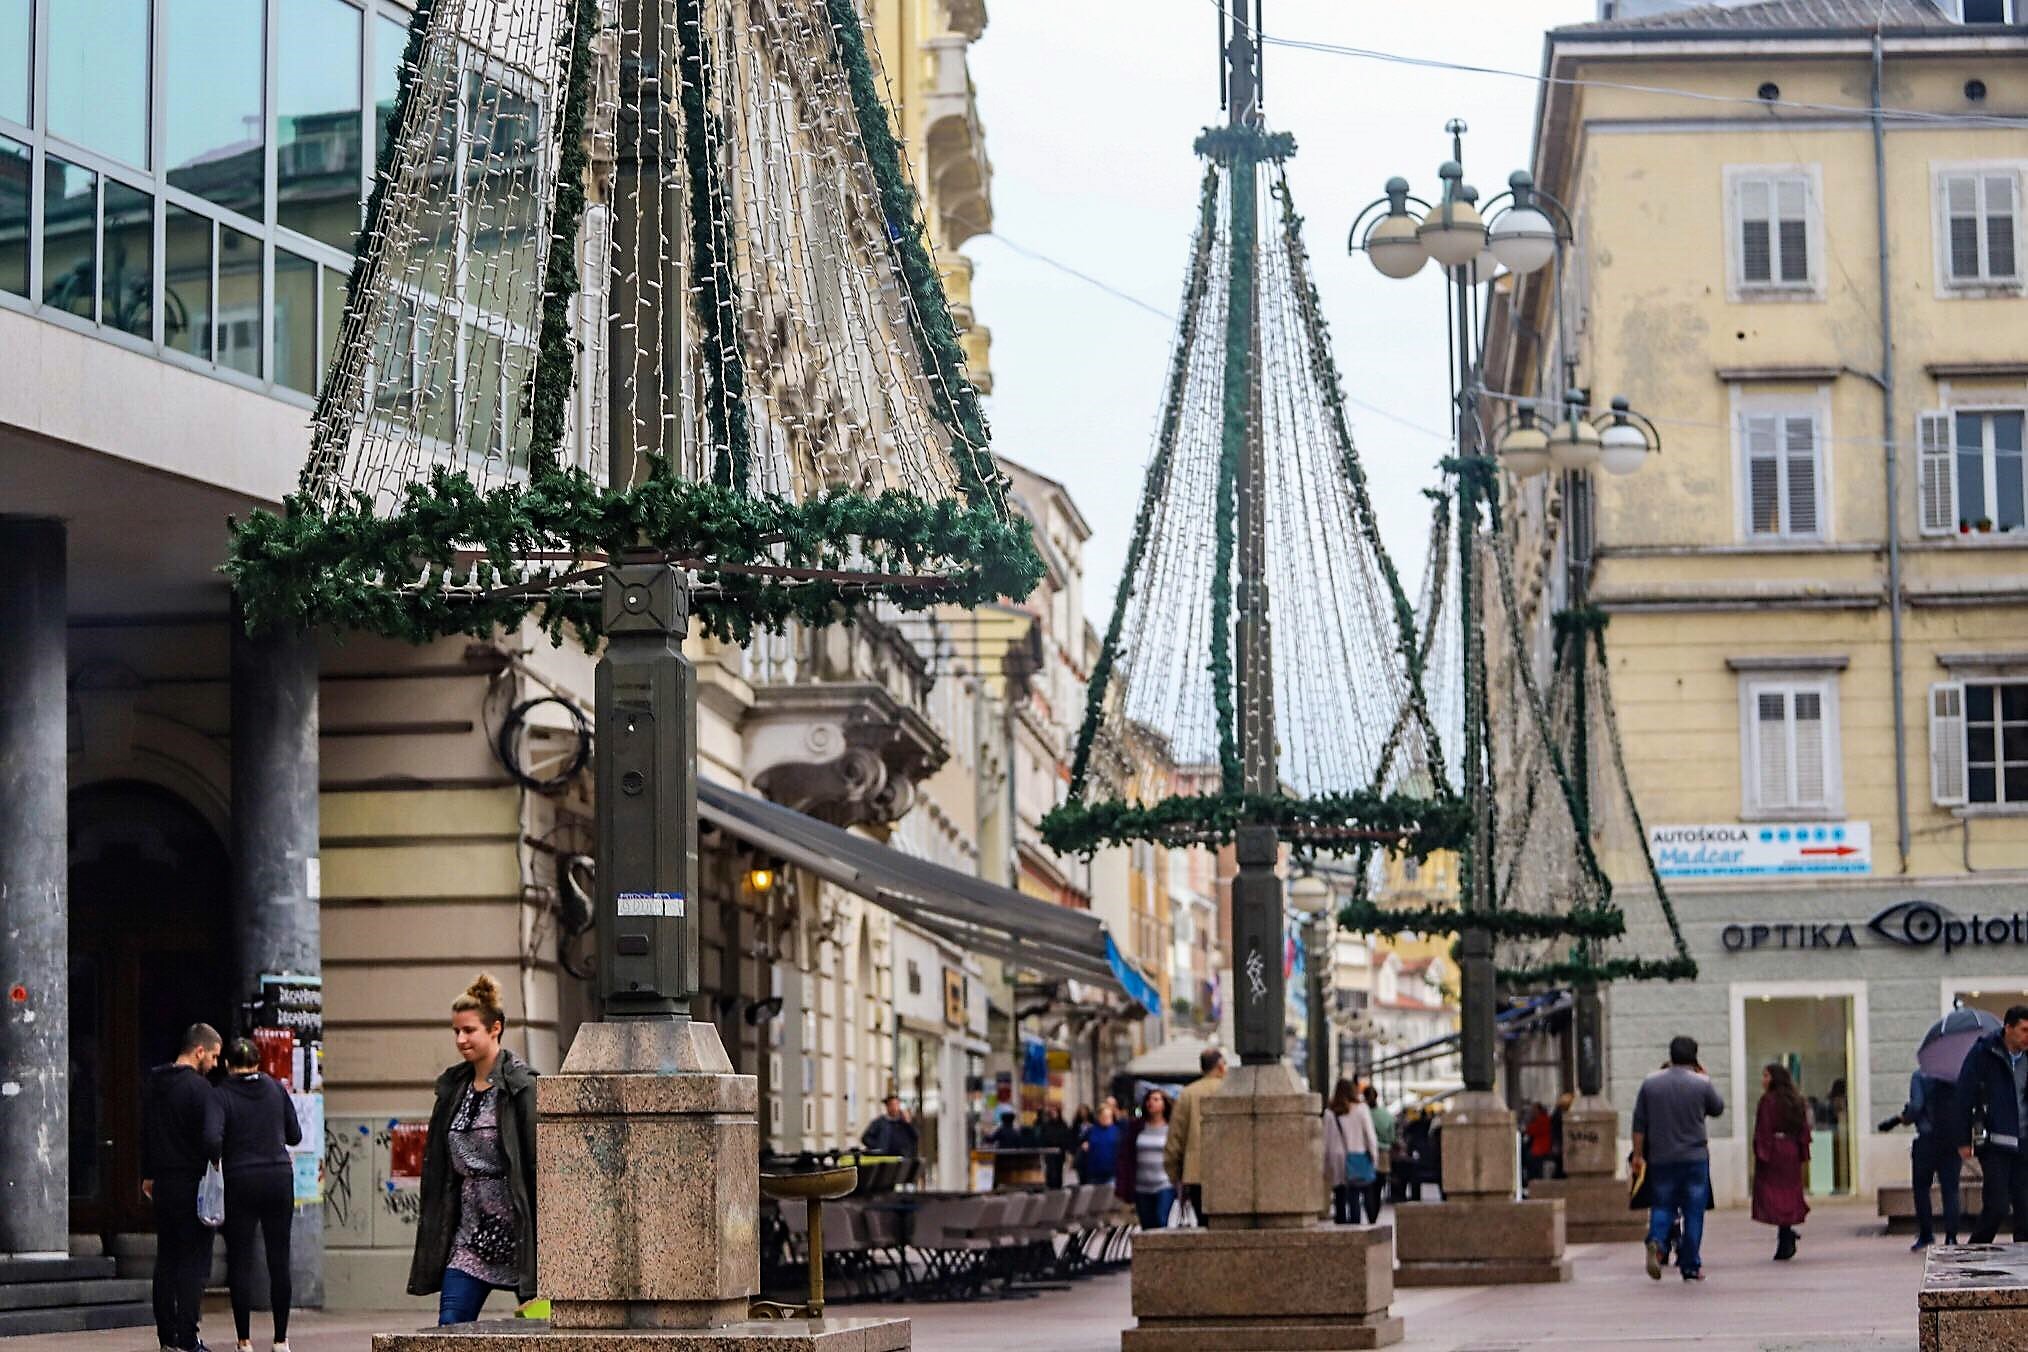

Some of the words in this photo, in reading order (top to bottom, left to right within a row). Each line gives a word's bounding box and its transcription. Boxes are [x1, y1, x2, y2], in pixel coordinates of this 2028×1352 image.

[1653, 828, 1749, 844] AUTOŠKOLA
[1722, 923, 1857, 952] OPTIKA
[1902, 905, 2028, 952] Optot
